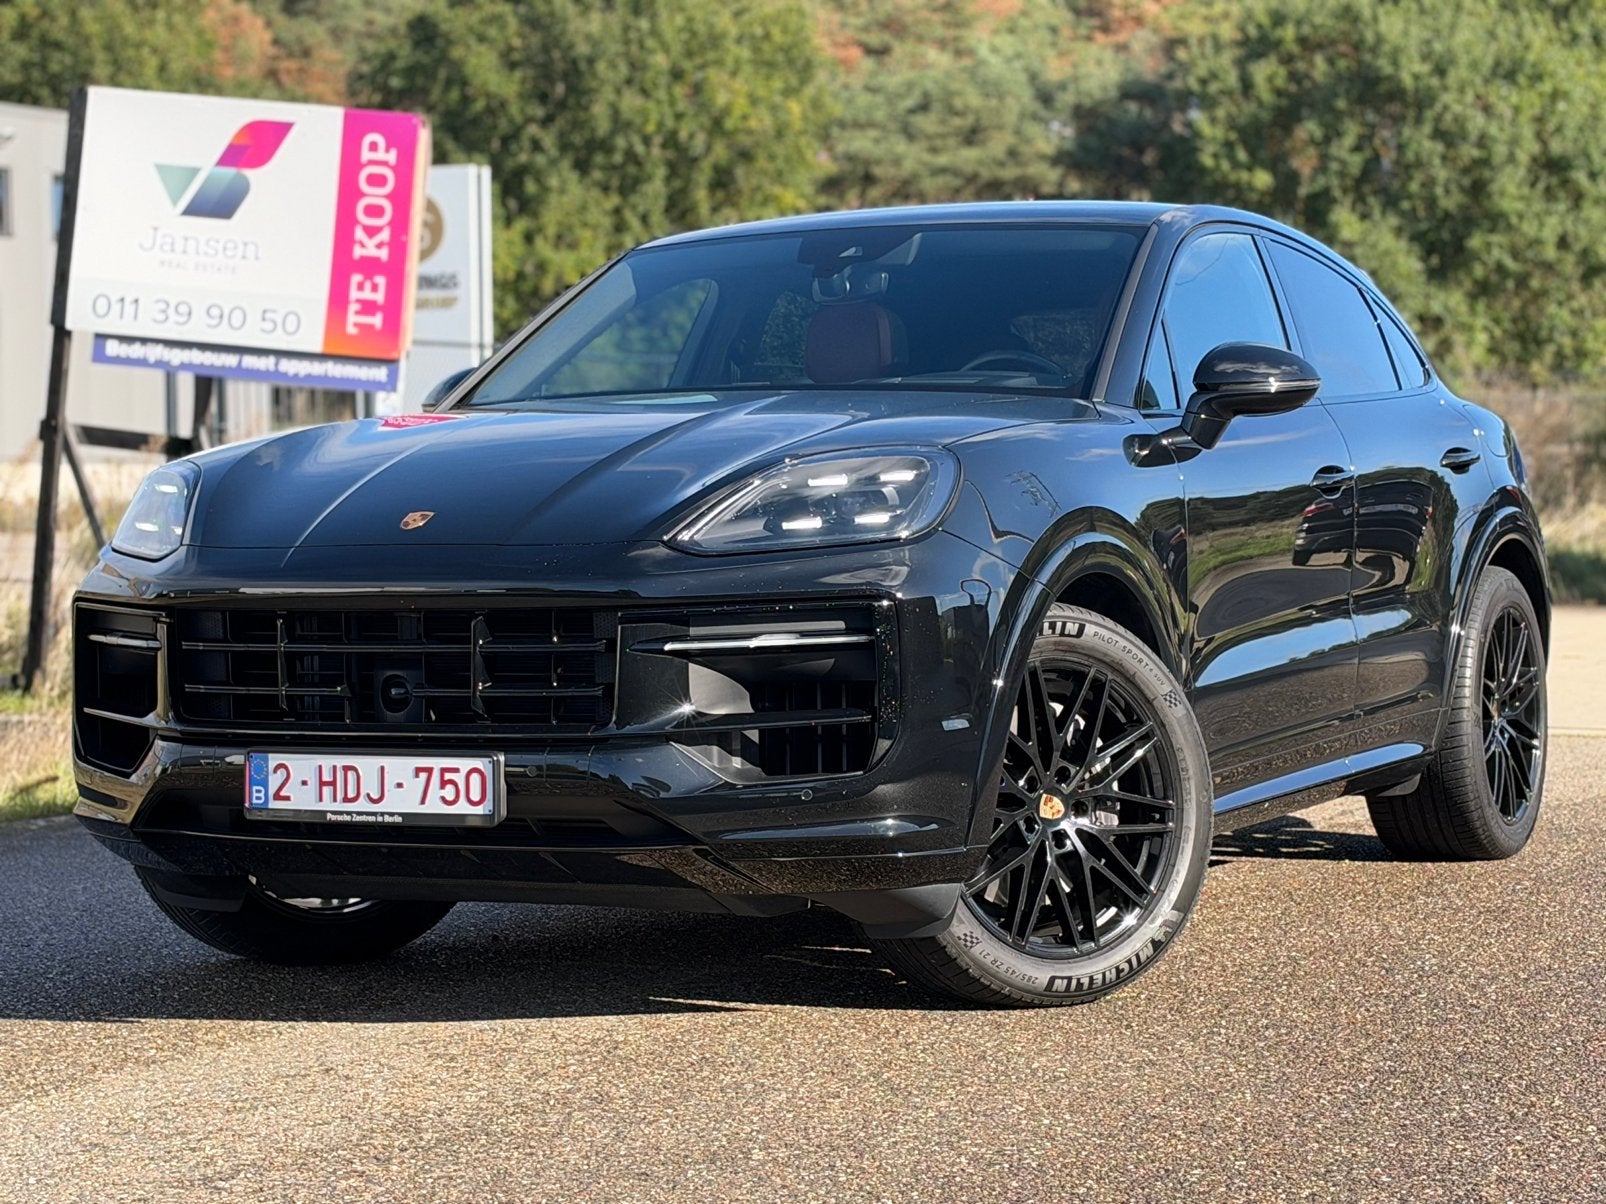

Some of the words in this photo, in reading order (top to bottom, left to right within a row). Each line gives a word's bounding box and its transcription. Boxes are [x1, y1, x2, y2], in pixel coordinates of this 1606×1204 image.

[352, 132, 398, 262] KOOP
[138, 226, 261, 261] Jansen
[92, 293, 140, 321] 011
[152, 299, 192, 326] 39
[206, 303, 247, 331] 90
[260, 308, 301, 336] 50
[346, 273, 387, 335] TE
[104, 338, 240, 368] Bedrijfsgebouw
[241, 354, 276, 372] met
[277, 358, 389, 383] appartement
[1093, 631, 1119, 647] PILOT
[1121, 645, 1149, 669] SPORT
[1154, 673, 1166, 686] SUV
[252, 786, 265, 804] B
[272, 762, 487, 807] 2-HDJ-750
[326, 812, 351, 822] Porsche
[351, 813, 376, 822] Zentren
[376, 813, 383, 822] in
[383, 814, 403, 823] Berlin
[979, 949, 991, 959] 21
[990, 958, 1005, 970] ZR
[1004, 966, 1039, 985] 285/45
[1051, 941, 1154, 992] MICHELIN
